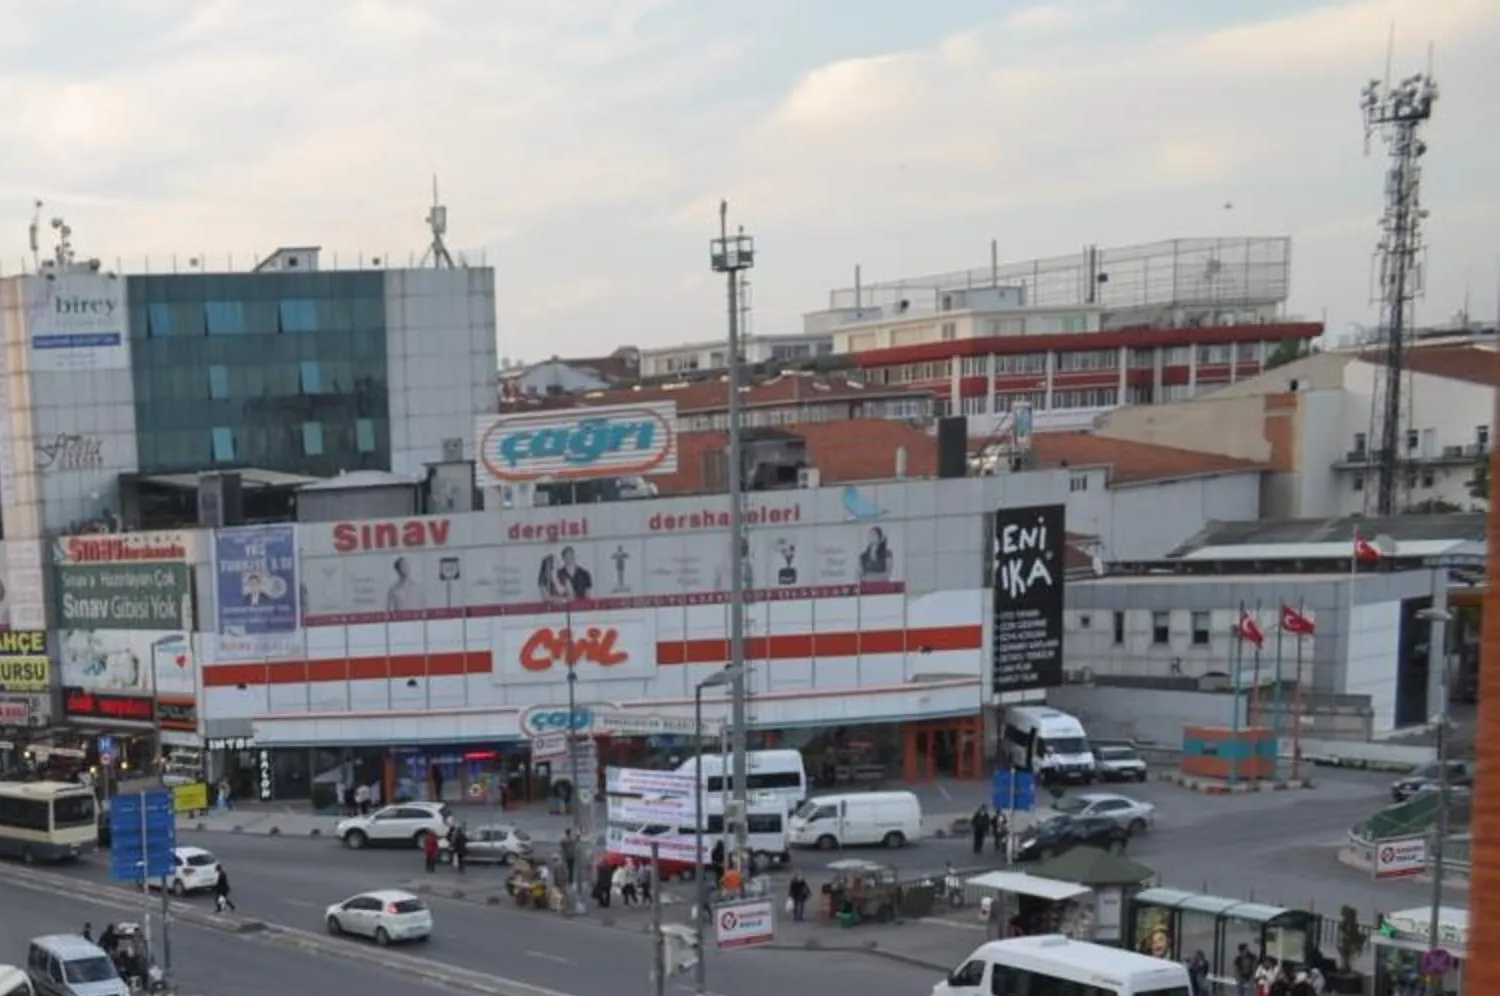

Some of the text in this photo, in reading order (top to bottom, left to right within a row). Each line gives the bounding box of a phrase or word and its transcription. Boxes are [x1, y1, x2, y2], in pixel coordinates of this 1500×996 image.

[55, 296, 118, 317] birey
[62, 592, 110, 621] Sınav
[151, 593, 177, 619] Yok
